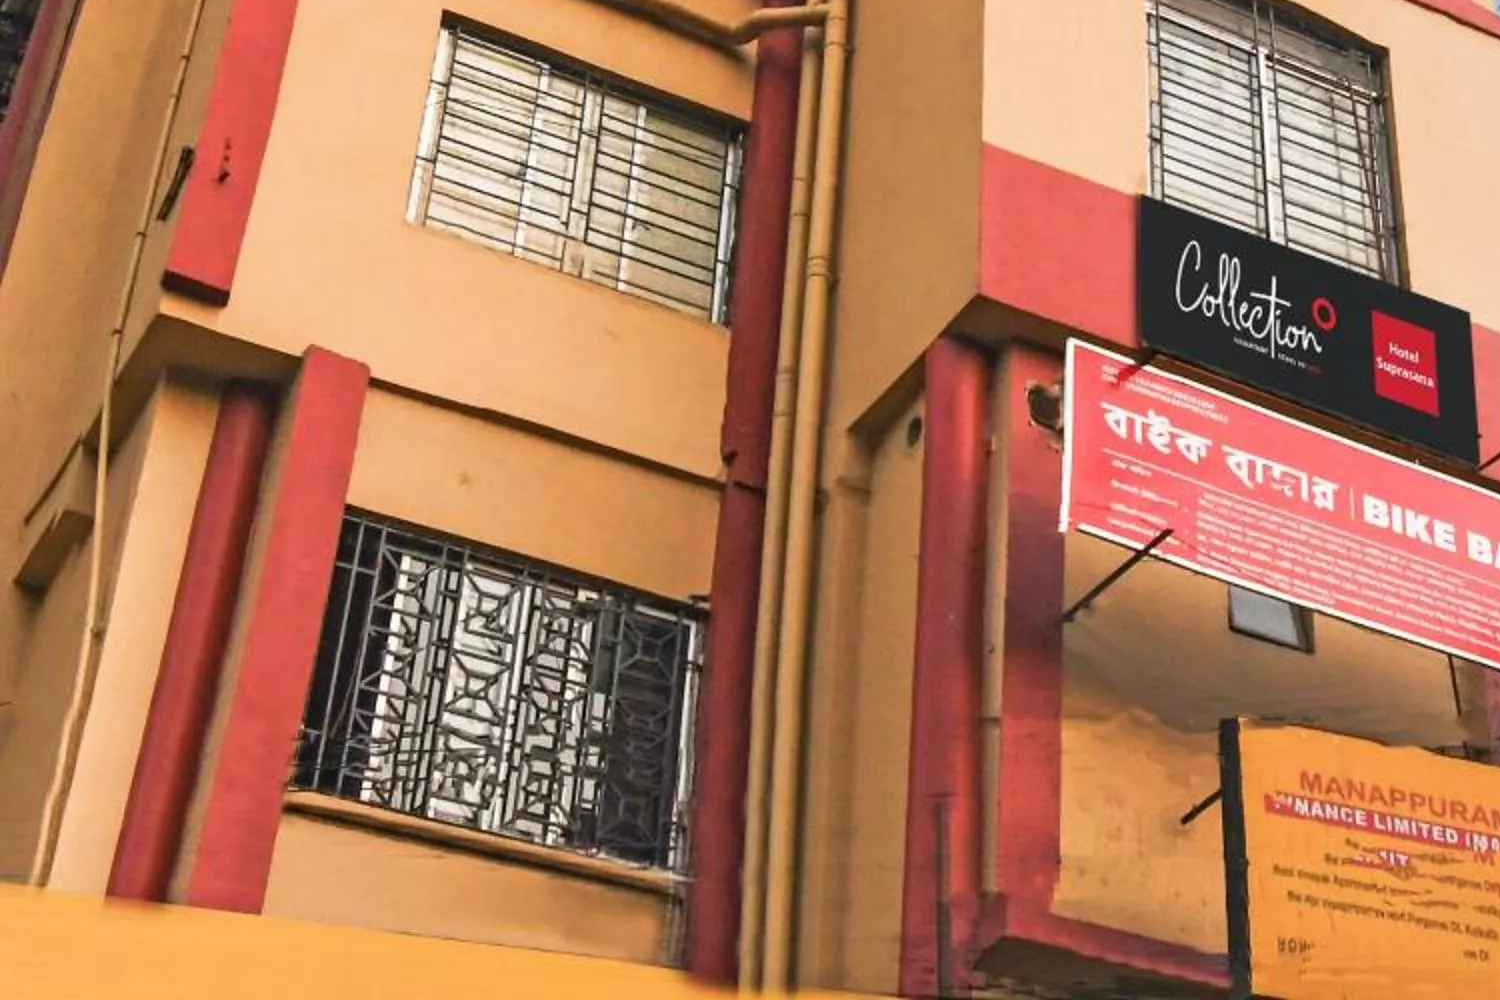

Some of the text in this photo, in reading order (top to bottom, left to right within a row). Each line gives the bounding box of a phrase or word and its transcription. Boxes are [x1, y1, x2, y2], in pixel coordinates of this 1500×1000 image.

[1175, 240, 1323, 359] Collection
[1388, 341, 1420, 365] Hotel
[1099, 401, 1214, 466] বাইক
[1361, 493, 1457, 554] BIKE
[1372, 812, 1459, 845] LIMITED
